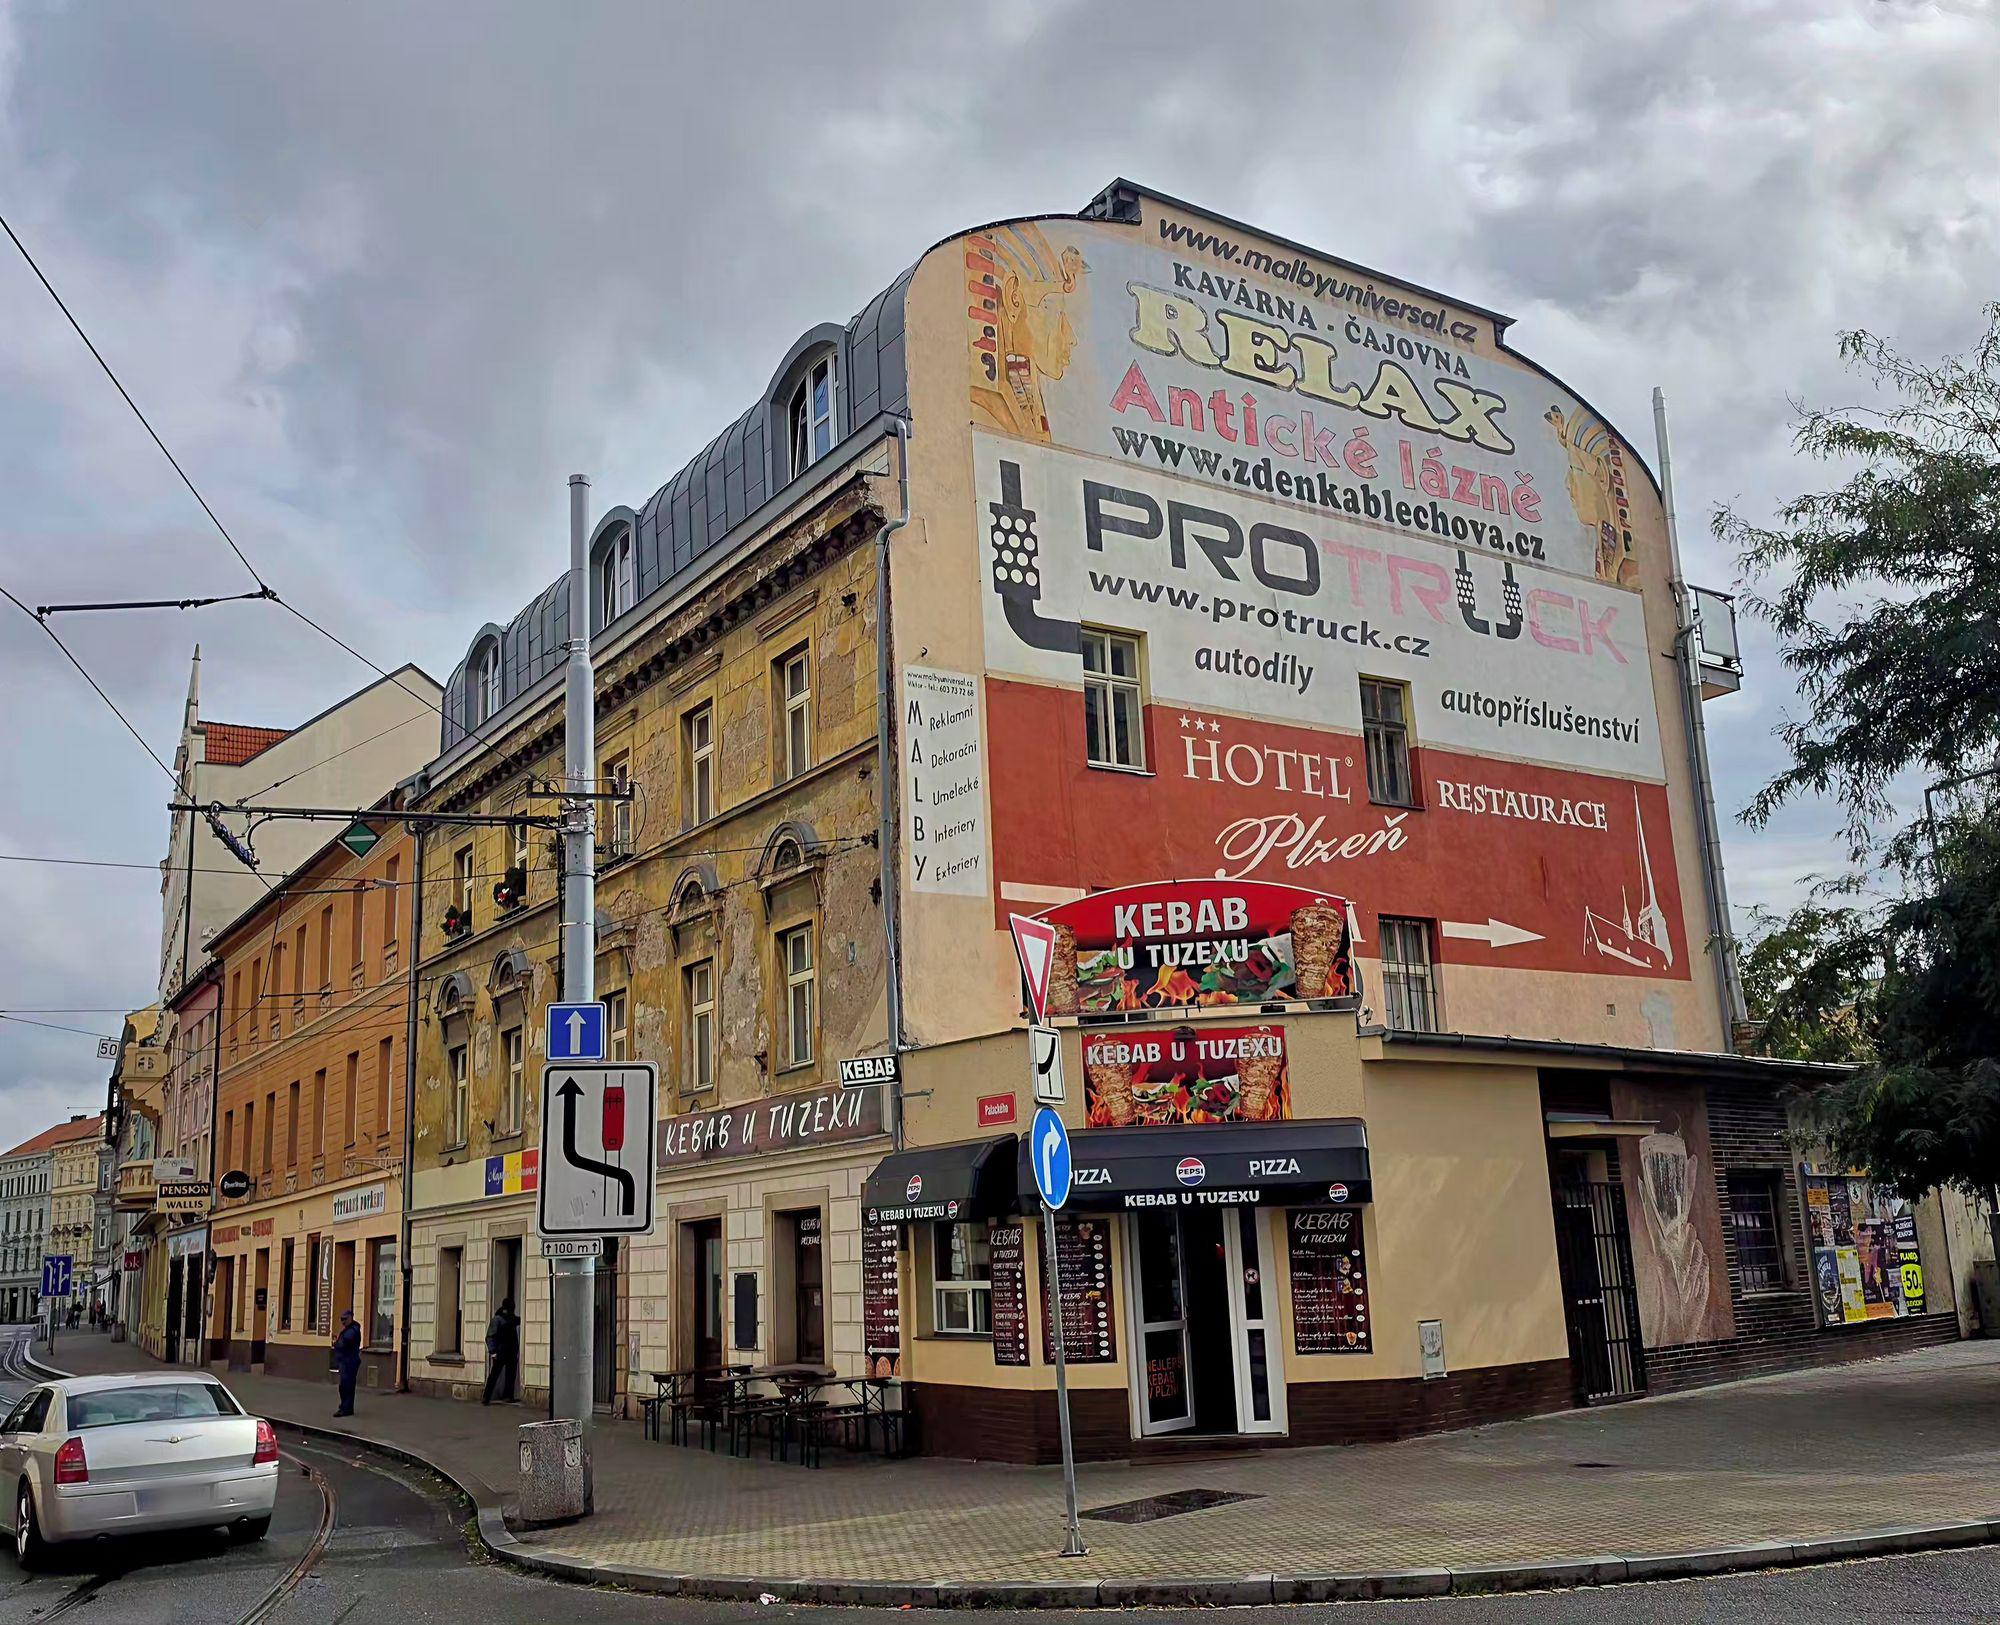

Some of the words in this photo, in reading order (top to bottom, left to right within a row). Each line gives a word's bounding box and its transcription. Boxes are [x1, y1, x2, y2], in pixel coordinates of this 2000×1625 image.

[1159, 219, 1478, 343] www.malbyuniversal.cz
[1173, 262, 1318, 331] KAVÁRNA
[1345, 313, 1471, 379] ČAJOVNA
[1126, 281, 1515, 455] RELAX
[1110, 360, 1379, 478] Antické
[1399, 440, 1542, 522] lázně
[1112, 426, 1546, 560] www.zdenkablechova.cz
[1083, 479, 1629, 664] PROTRUCK
[1089, 570, 1430, 658] www.protruck.cz
[1194, 646, 1313, 695] autodíly
[929, 704, 974, 731] Reklamní
[1441, 688, 1640, 745] autopříslušenství
[1180, 735, 1352, 805] HOTEL
[1437, 779, 1608, 832] RESTAURACE
[934, 818, 976, 844] Interiery
[1214, 811, 1410, 881] Plzeň
[936, 854, 980, 882] Exteriery
[1114, 897, 1250, 939] KEBAB
[1116, 946, 1134, 970] U
[1146, 938, 1250, 968] TUZEXU
[101, 1043, 118, 1056] 50
[1087, 1042, 1161, 1066] KEBAB
[1170, 1041, 1186, 1062] U
[1195, 1036, 1283, 1060] TUZEXU
[841, 1057, 896, 1080] KEBAB
[665, 1114, 732, 1156] KEBAB
[742, 1110, 757, 1145] U
[769, 1089, 865, 1140] TUZEXU
[1177, 1166, 1205, 1177] PEPSI
[1249, 1158, 1300, 1177] PIZZA
[161, 1184, 209, 1195] PENSION
[166, 1200, 204, 1209] WALLIS
[1124, 1193, 1177, 1207] KEBAB
[1181, 1192, 1192, 1205] U
[1196, 1190, 1260, 1204] TUZEXU
[880, 1209, 904, 1222] KEBAB
[906, 1208, 912, 1219] U
[913, 1205, 945, 1219] TUZEXU
[1294, 1212, 1353, 1230] KEBAB
[555, 1243, 573, 1254] 100
[577, 1244, 588, 1253] m
[990, 1229, 1022, 1246] KEBAB
[1300, 1234, 1309, 1244] U
[1311, 1233, 1347, 1244] TUZEXU
